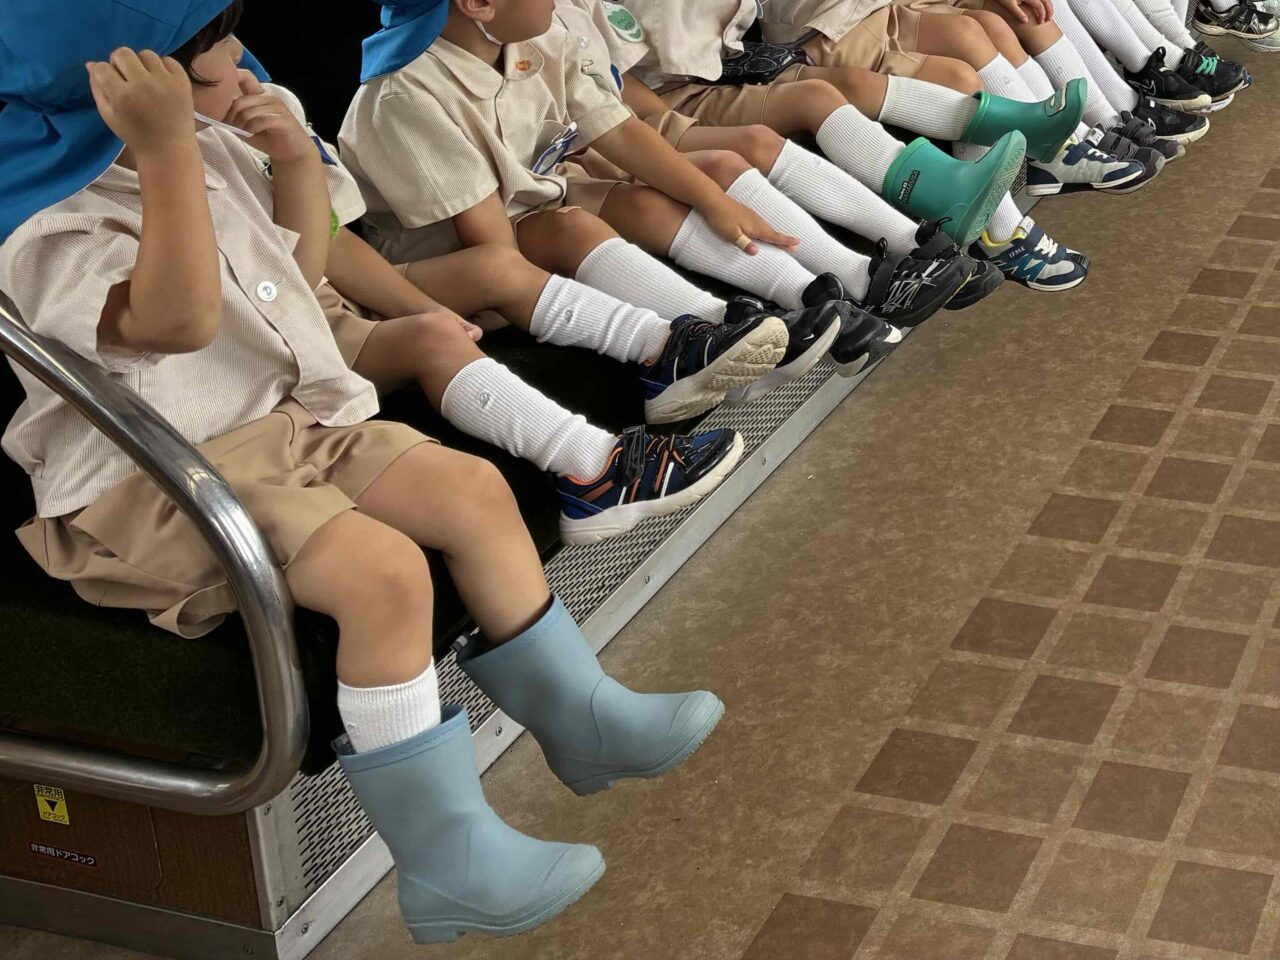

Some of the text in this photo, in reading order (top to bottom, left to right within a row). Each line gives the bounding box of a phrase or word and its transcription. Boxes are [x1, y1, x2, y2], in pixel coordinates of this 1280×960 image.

[35, 785, 64, 799] 非常用
[31, 843, 96, 865] 非常用ドアコック
